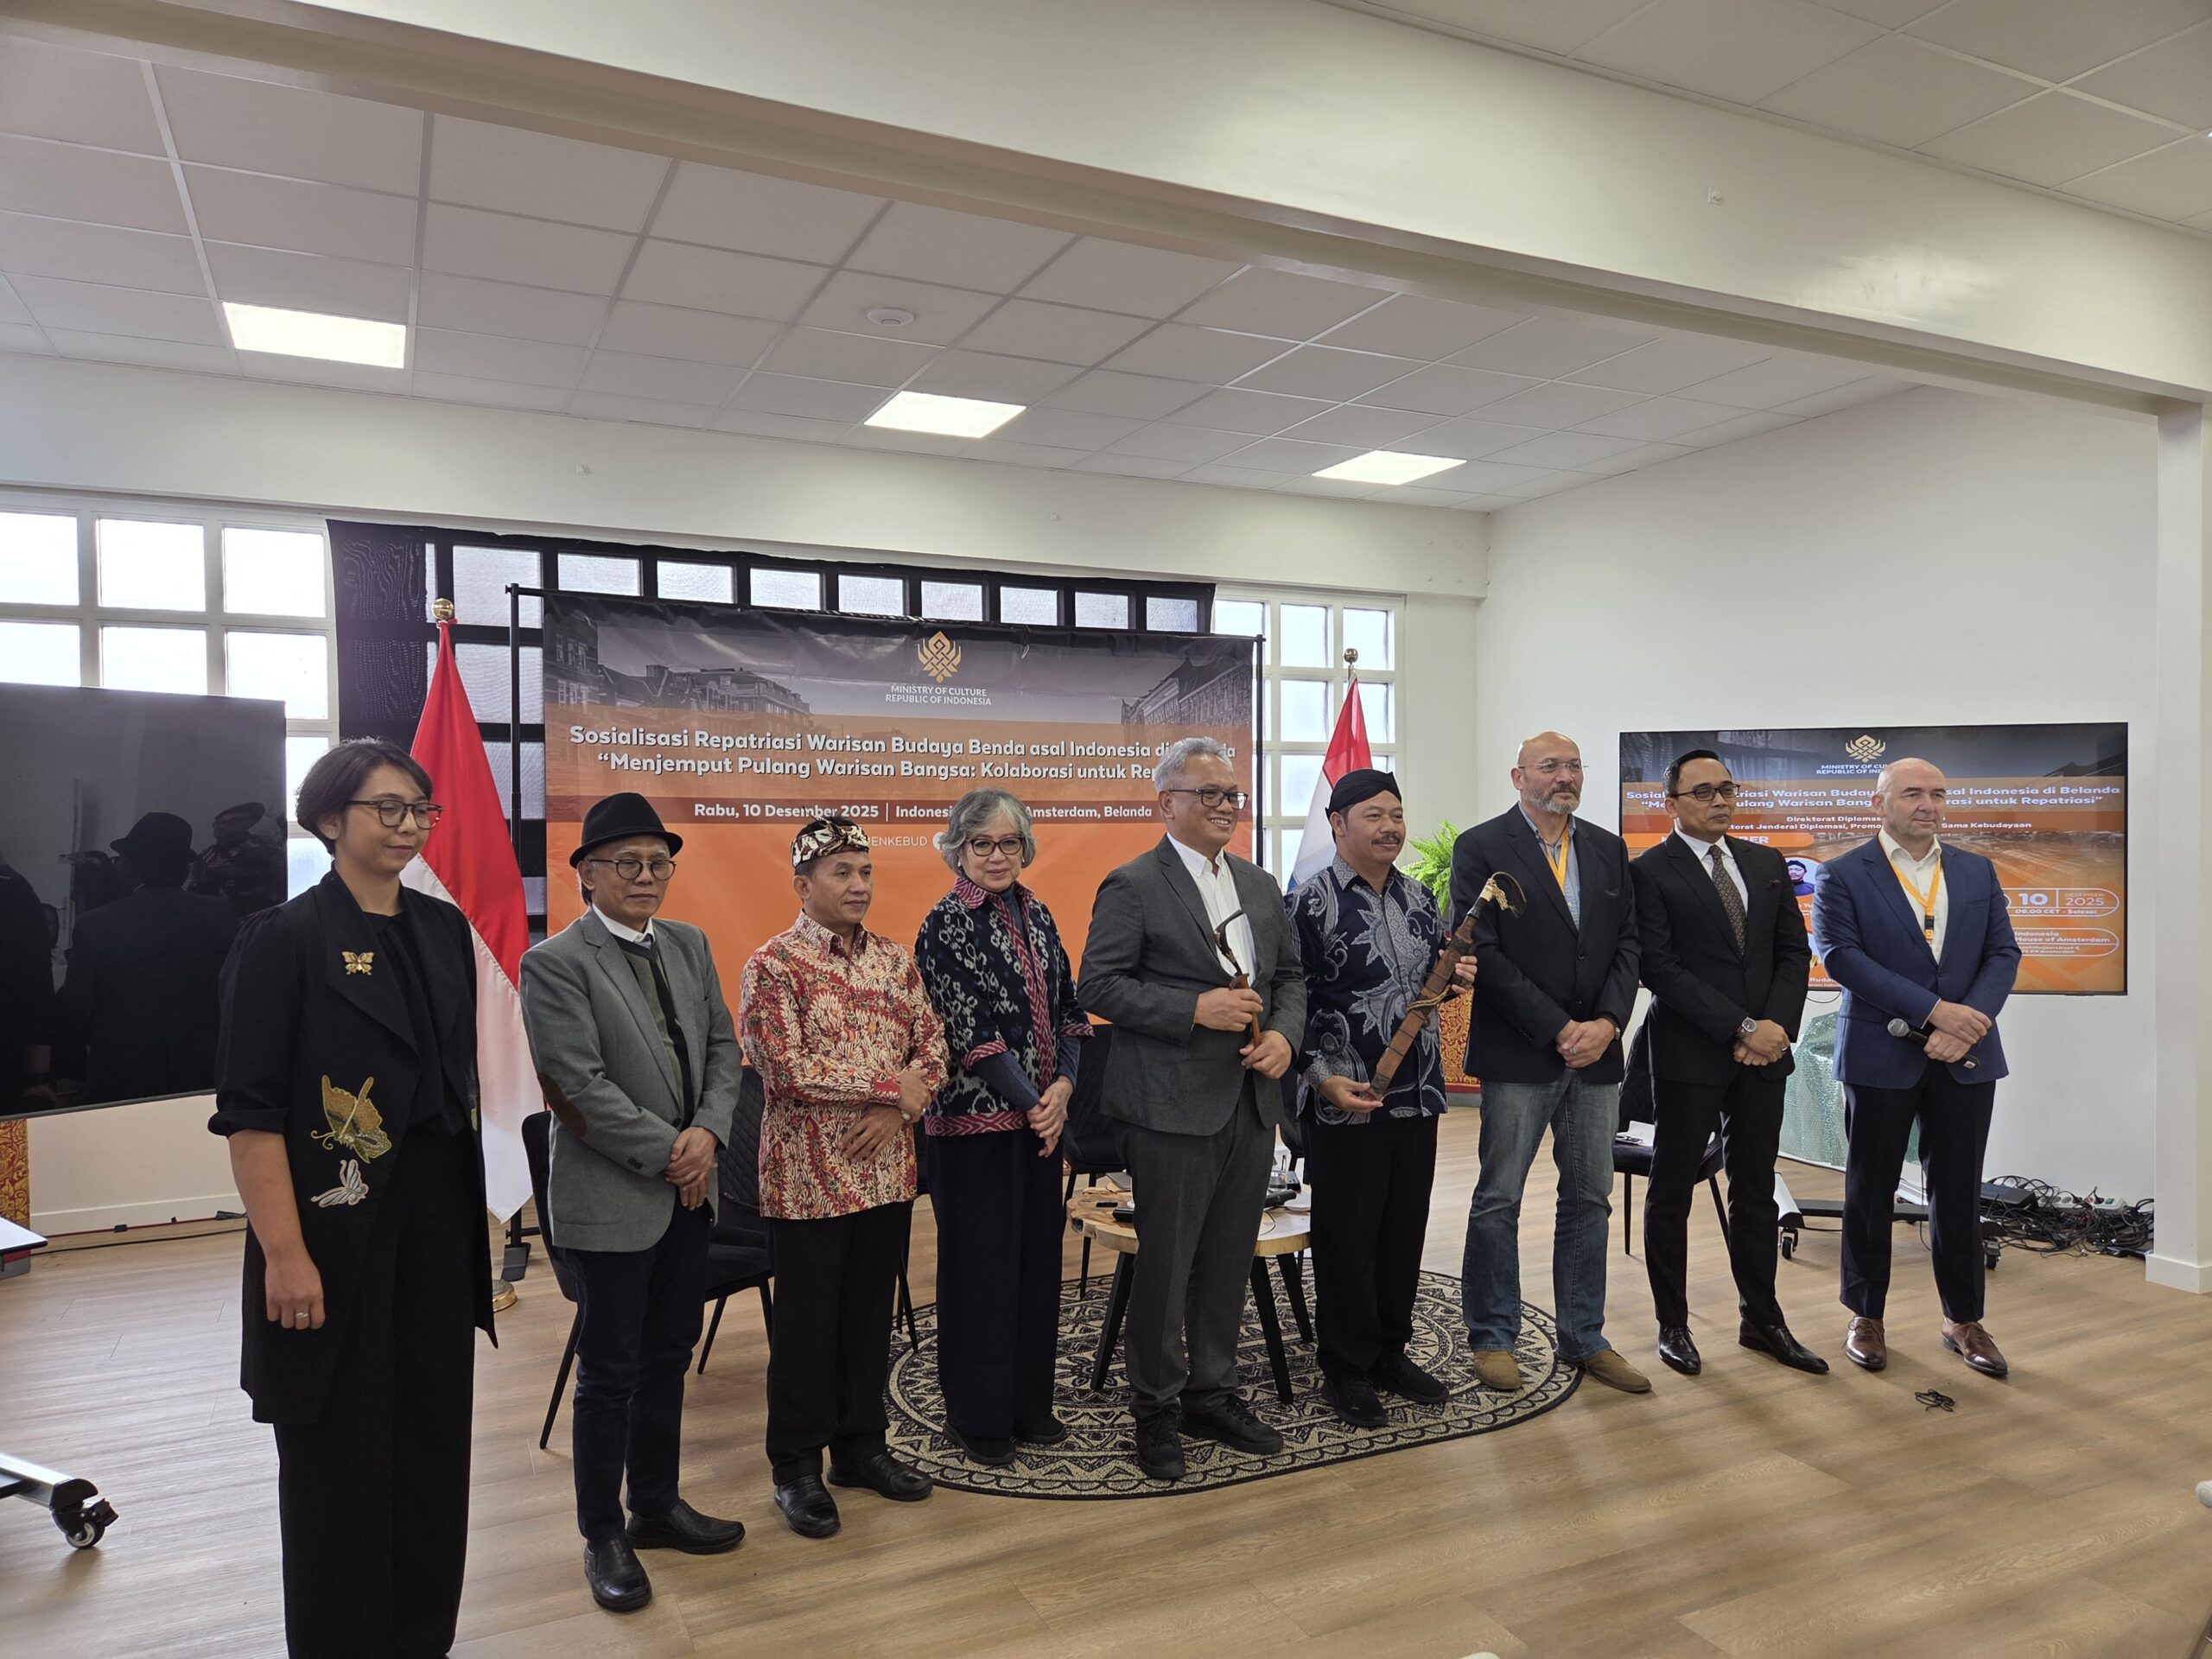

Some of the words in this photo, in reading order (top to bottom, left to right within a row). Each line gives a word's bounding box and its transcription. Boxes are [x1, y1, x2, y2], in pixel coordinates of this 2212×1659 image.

[891, 685, 933, 694] MINISTRY
[935, 686, 947, 695] OF
[949, 687, 987, 696] CULTURE
[886, 694, 928, 703] REPUBLIC
[944, 696, 991, 705] INDONESIA
[569, 725, 689, 747] Sosialisasi
[695, 730, 802, 752] Repatriasi
[806, 734, 887, 753] Warisan
[892, 736, 963, 758] Budaya
[969, 739, 1025, 755] Benda
[1030, 741, 1065, 756] asal
[1071, 741, 1151, 758] Indonesia
[598, 753, 733, 775] “Menjemput
[739, 757, 810, 778] Pulang
[816, 759, 895, 777] Warisan
[900, 760, 976, 780] Bangsa:
[981, 762, 1073, 779] Kolaborasi
[1077, 764, 1127, 779] untuk
[1831, 789, 1875, 798] Buday
[1736, 799, 1775, 808] ulang
[1836, 798, 1872, 808] Bang
[1975, 797, 2018, 805] untuk
[2021, 796, 2103, 805] Repatriasi”
[695, 804, 740, 818] Rabu,
[743, 804, 760, 817] 10
[766, 805, 837, 818] Desember
[841, 805, 879, 817] 2025
[896, 805, 952, 817] Indonesi
[1104, 806, 1152, 817] Belanda
[868, 836, 927, 847] ENKEBUD
[2018, 893, 2049, 906] 10
[2065, 898, 2105, 906] 2025
